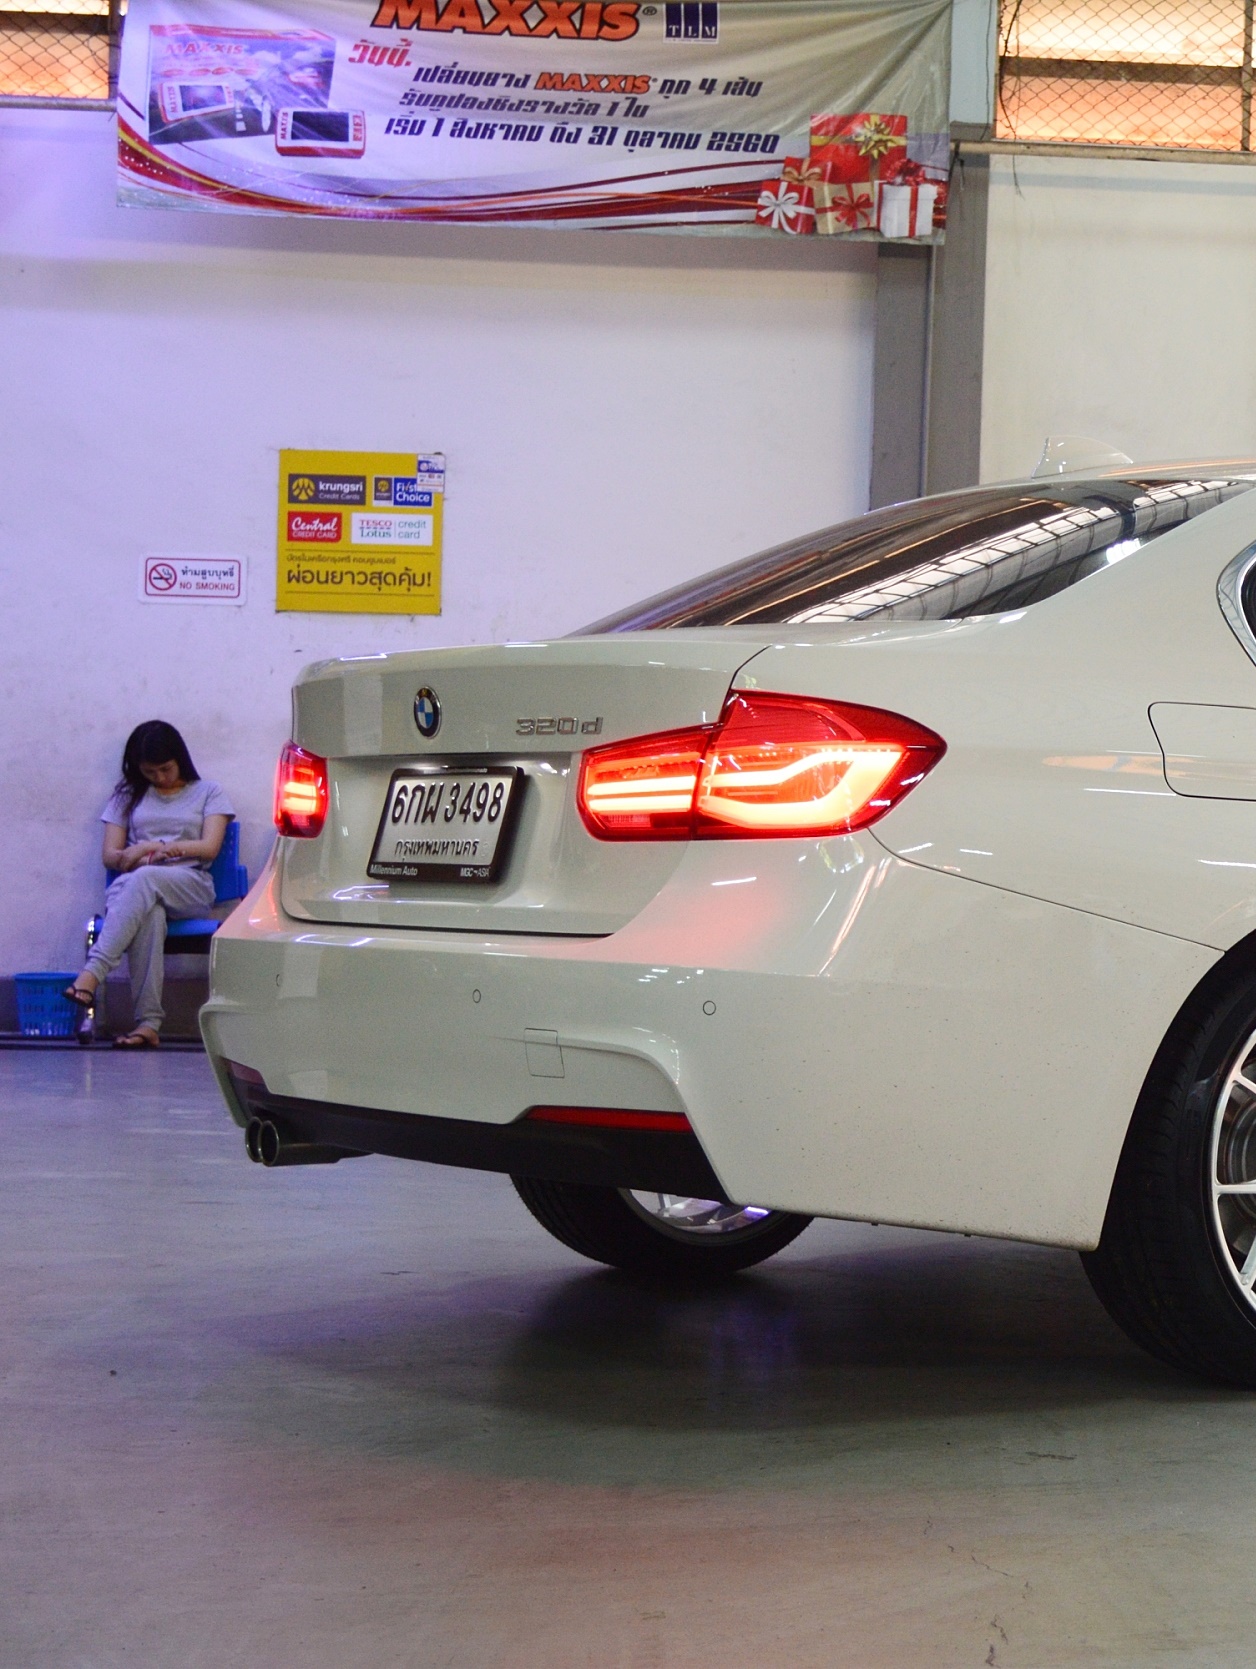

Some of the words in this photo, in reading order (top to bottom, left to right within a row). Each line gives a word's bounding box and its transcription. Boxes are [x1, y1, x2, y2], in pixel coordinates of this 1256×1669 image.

[370, 0, 641, 42] MAXXIS
[534, 72, 652, 95] MAXXIS
[658, 78, 691, 99] ทุก
[699, 78, 718, 95] 4
[384, 111, 427, 137] เริ่ม
[431, 117, 445, 138] 1
[449, 117, 545, 143] สิงหาคม
[587, 125, 619, 147] 31
[622, 129, 702, 153] ตุลาคม
[706, 131, 781, 154] 2560
[319, 481, 363, 493] krungsri
[396, 491, 430, 503] Choice
[291, 516, 338, 532] Central
[360, 519, 392, 527] TESCO
[398, 519, 426, 529] credit
[317, 531, 337, 539] CARD
[360, 528, 392, 538] Lotus
[398, 530, 420, 540] card
[287, 564, 431, 592] ผ่อนยาวสุดคุ้ม!
[196, 582, 235, 591] SMOKING
[444, 782, 504, 823] 3498
[394, 838, 479, 862] กรุงเทพมหานคร
[402, 866, 418, 876] Auto
